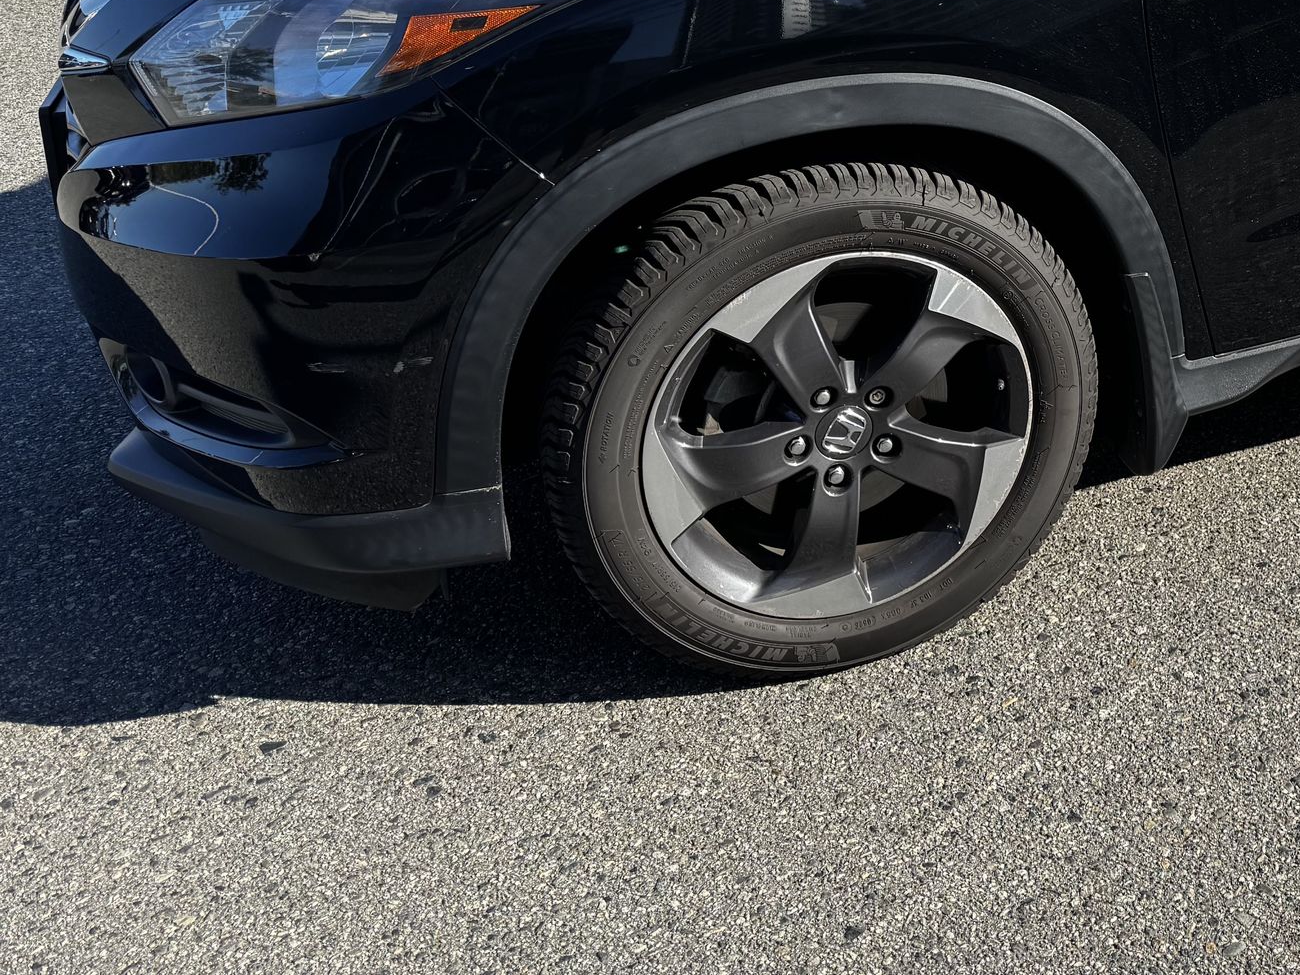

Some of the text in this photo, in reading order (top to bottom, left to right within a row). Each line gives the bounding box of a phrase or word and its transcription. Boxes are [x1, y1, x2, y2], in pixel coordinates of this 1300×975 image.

[910, 215, 1034, 285] MICHELIN
[600, 412, 614, 452] ROTATION
[656, 603, 788, 661] MICHELIN
